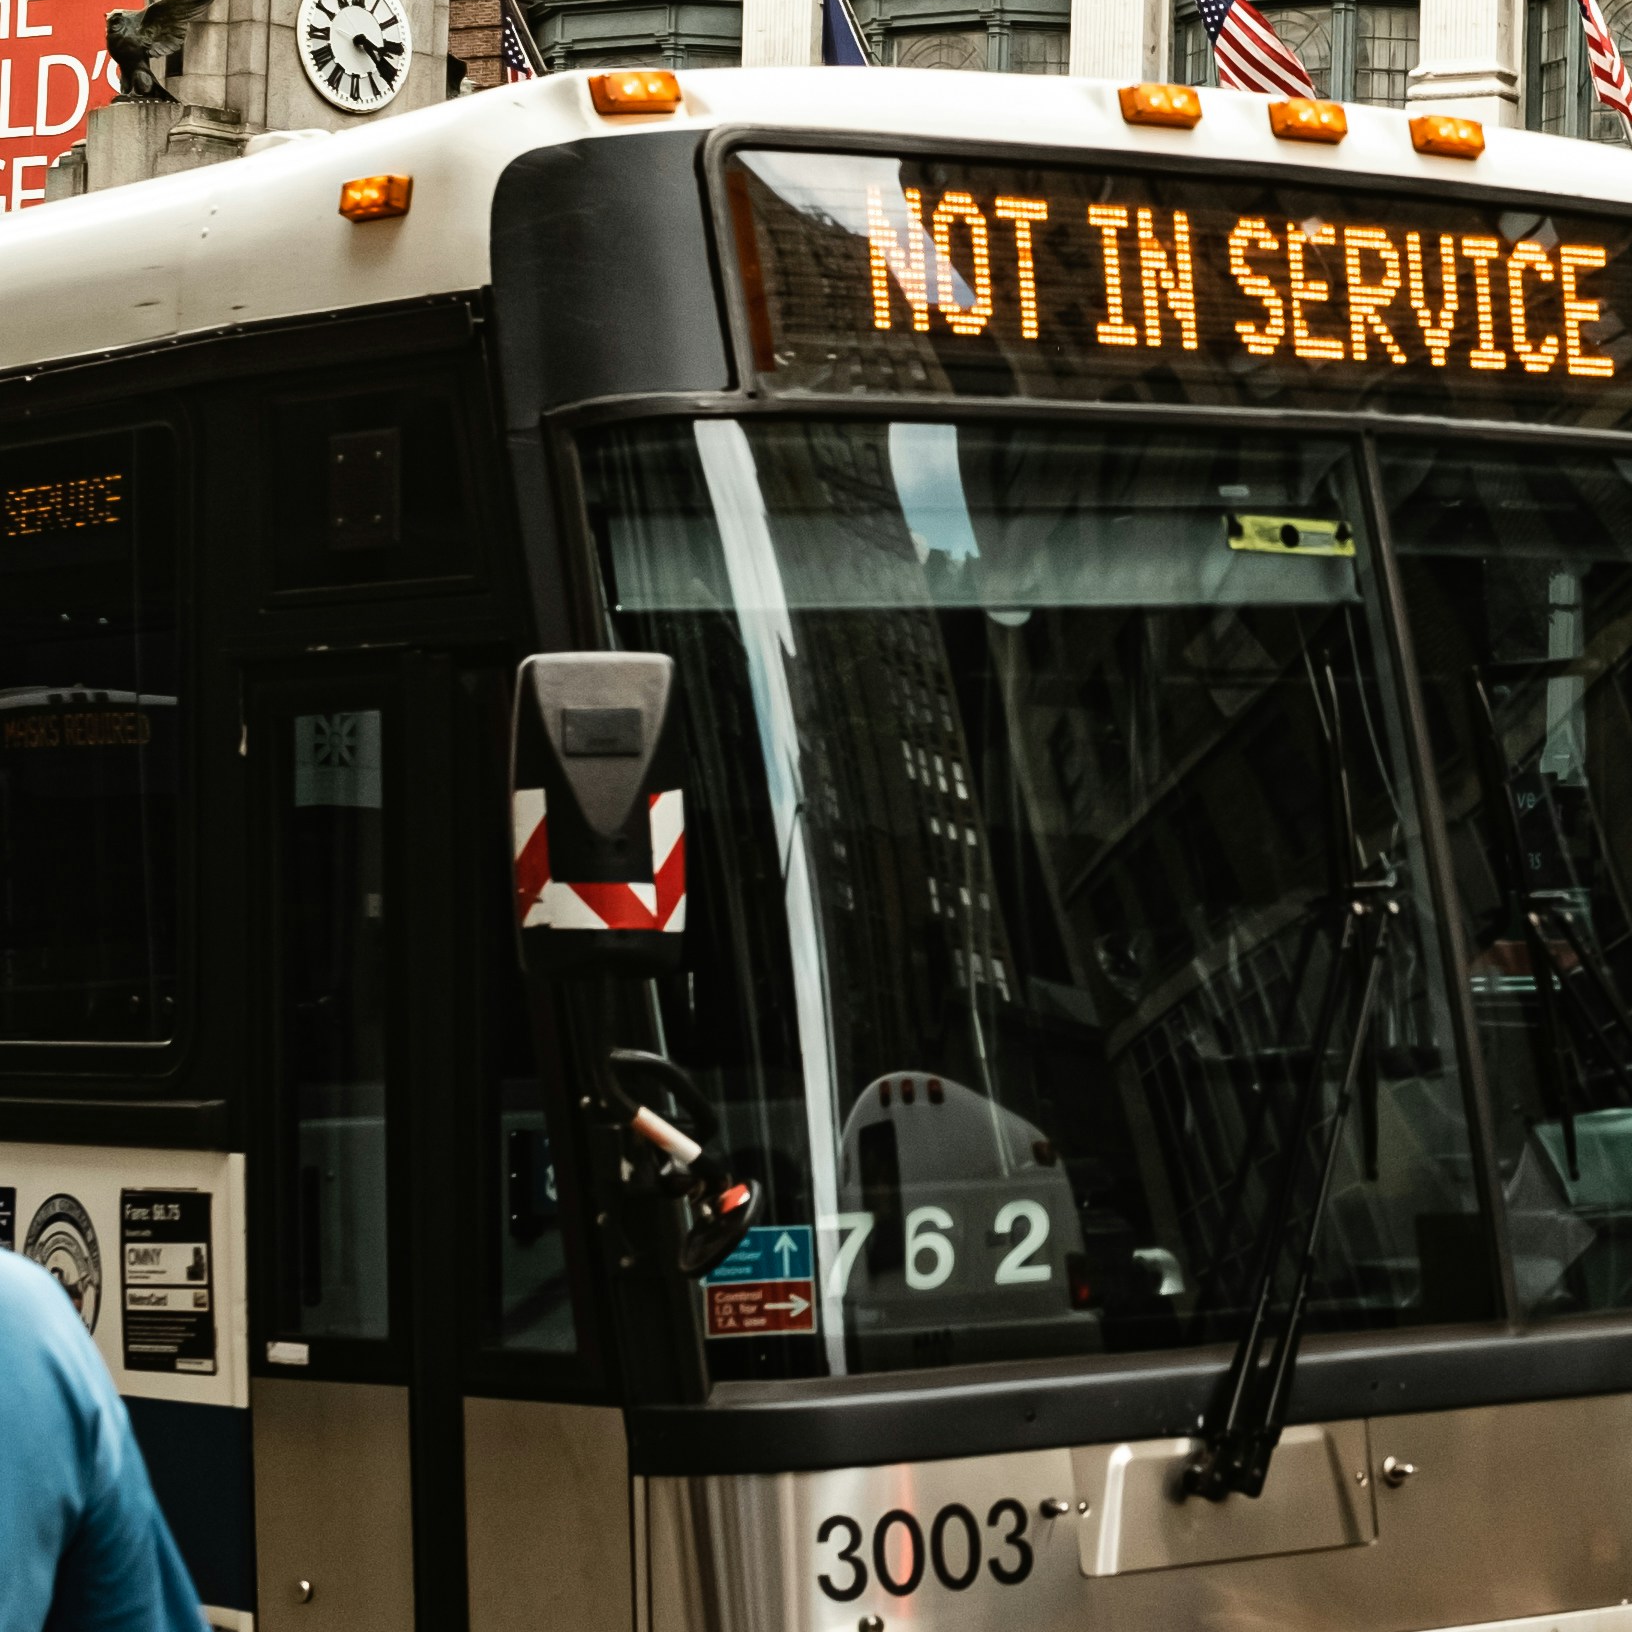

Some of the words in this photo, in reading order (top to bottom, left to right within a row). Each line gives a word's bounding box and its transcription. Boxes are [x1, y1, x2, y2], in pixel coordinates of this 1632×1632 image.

[867, 184, 1047, 338] NOT
[1087, 202, 1198, 350] IN
[1228, 214, 1616, 378] SERVICE
[4, 474, 122, 537] SERVICE
[64, 712, 151, 747] REQUIRED
[815, 1496, 1034, 1603] 3003
